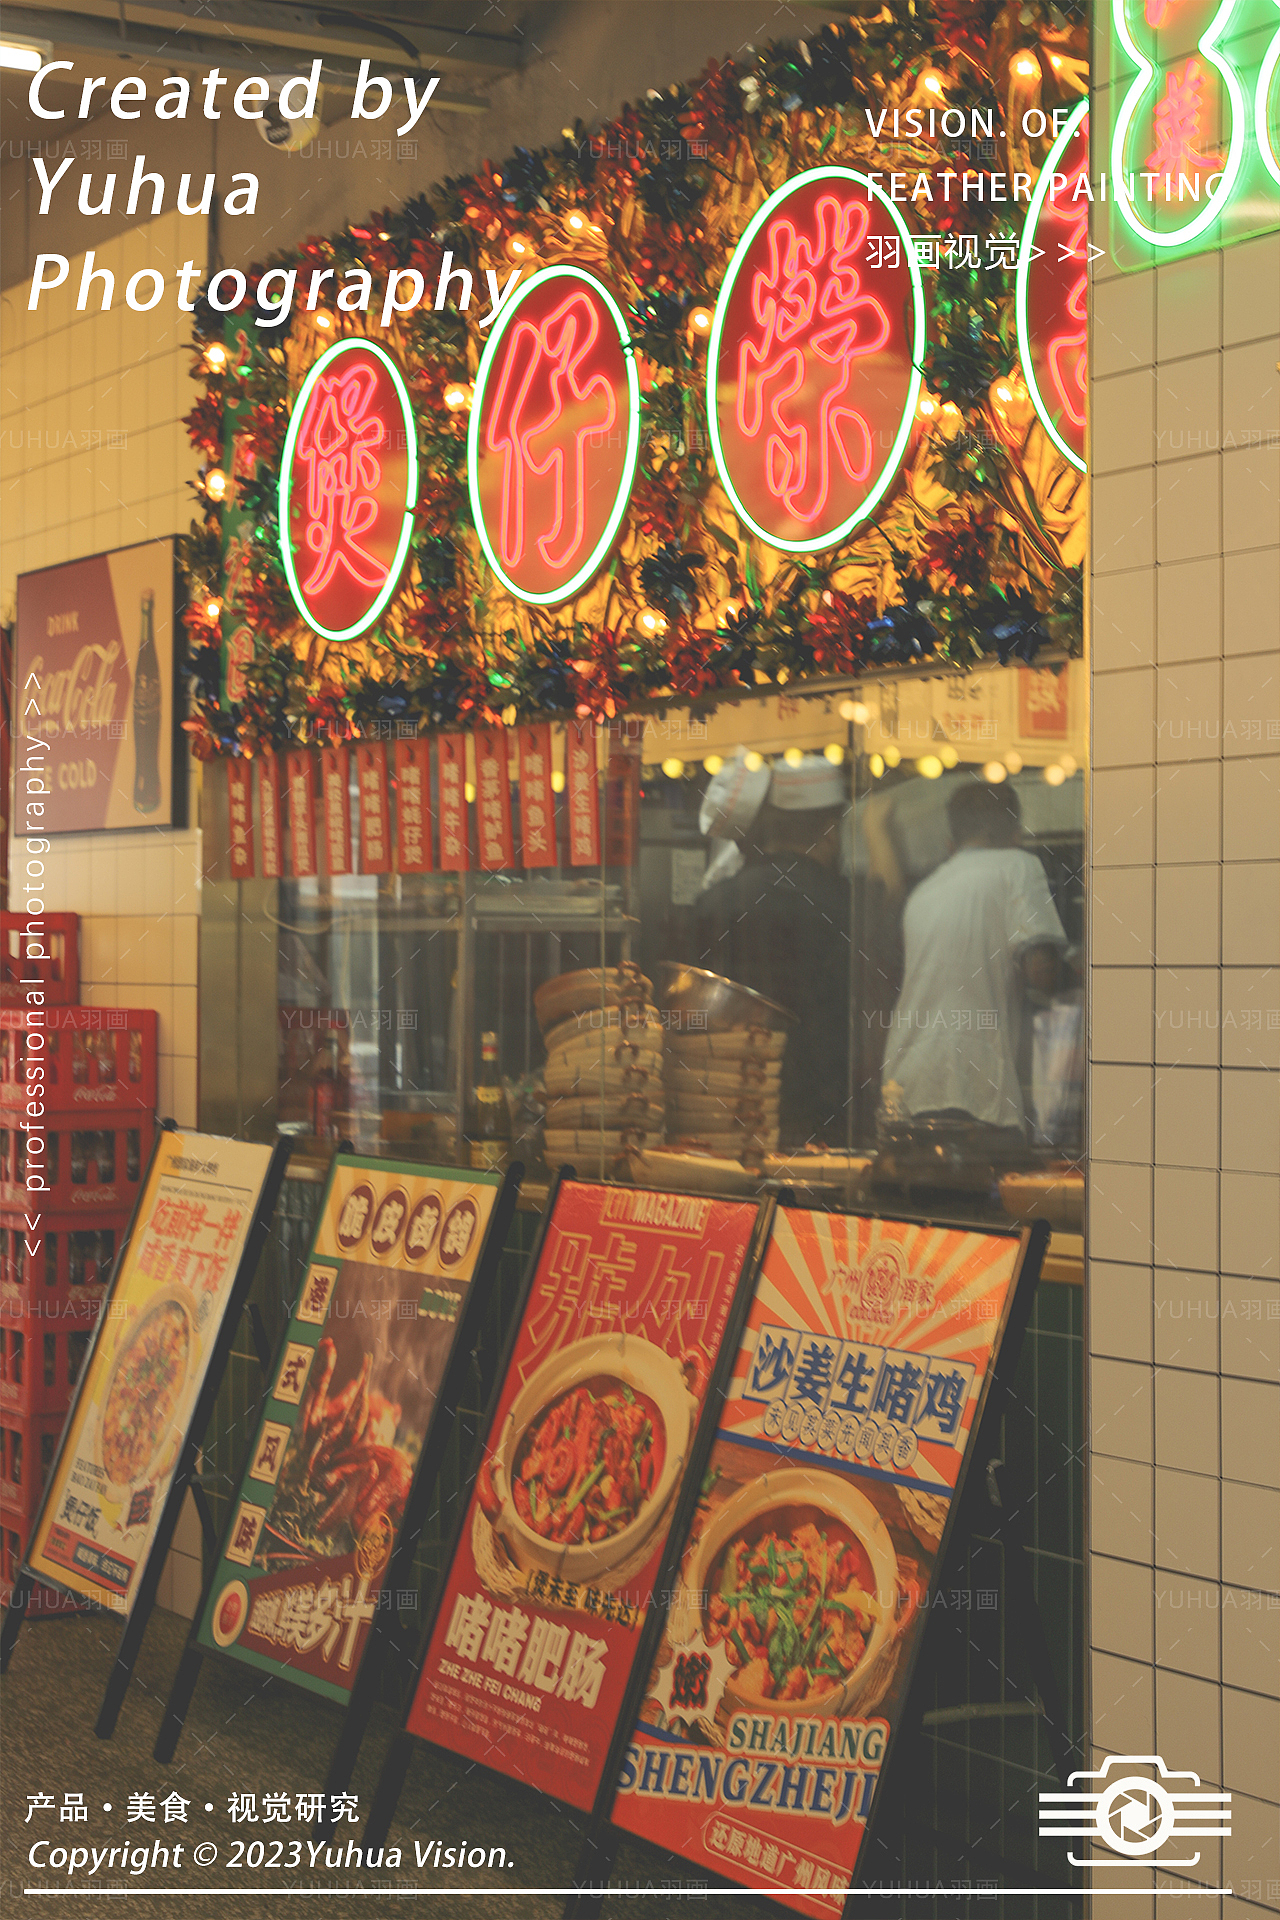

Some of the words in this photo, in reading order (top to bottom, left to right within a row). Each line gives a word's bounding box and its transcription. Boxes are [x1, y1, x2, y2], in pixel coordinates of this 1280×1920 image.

[45, 610, 80, 639] DRINK
[57, 758, 97, 791] COLD
[751, 1333, 968, 1435] 沙姜生啫鸡
[444, 1591, 610, 1710] 啫啫肥肠
[437, 1657, 462, 1682] ZHE
[460, 1666, 484, 1690] ZHE
[483, 1674, 503, 1696] FEI
[502, 1681, 543, 1714] CHANG
[730, 1716, 885, 1762] SHAJIANG
[617, 1748, 879, 1823] SHENGZHEJI
